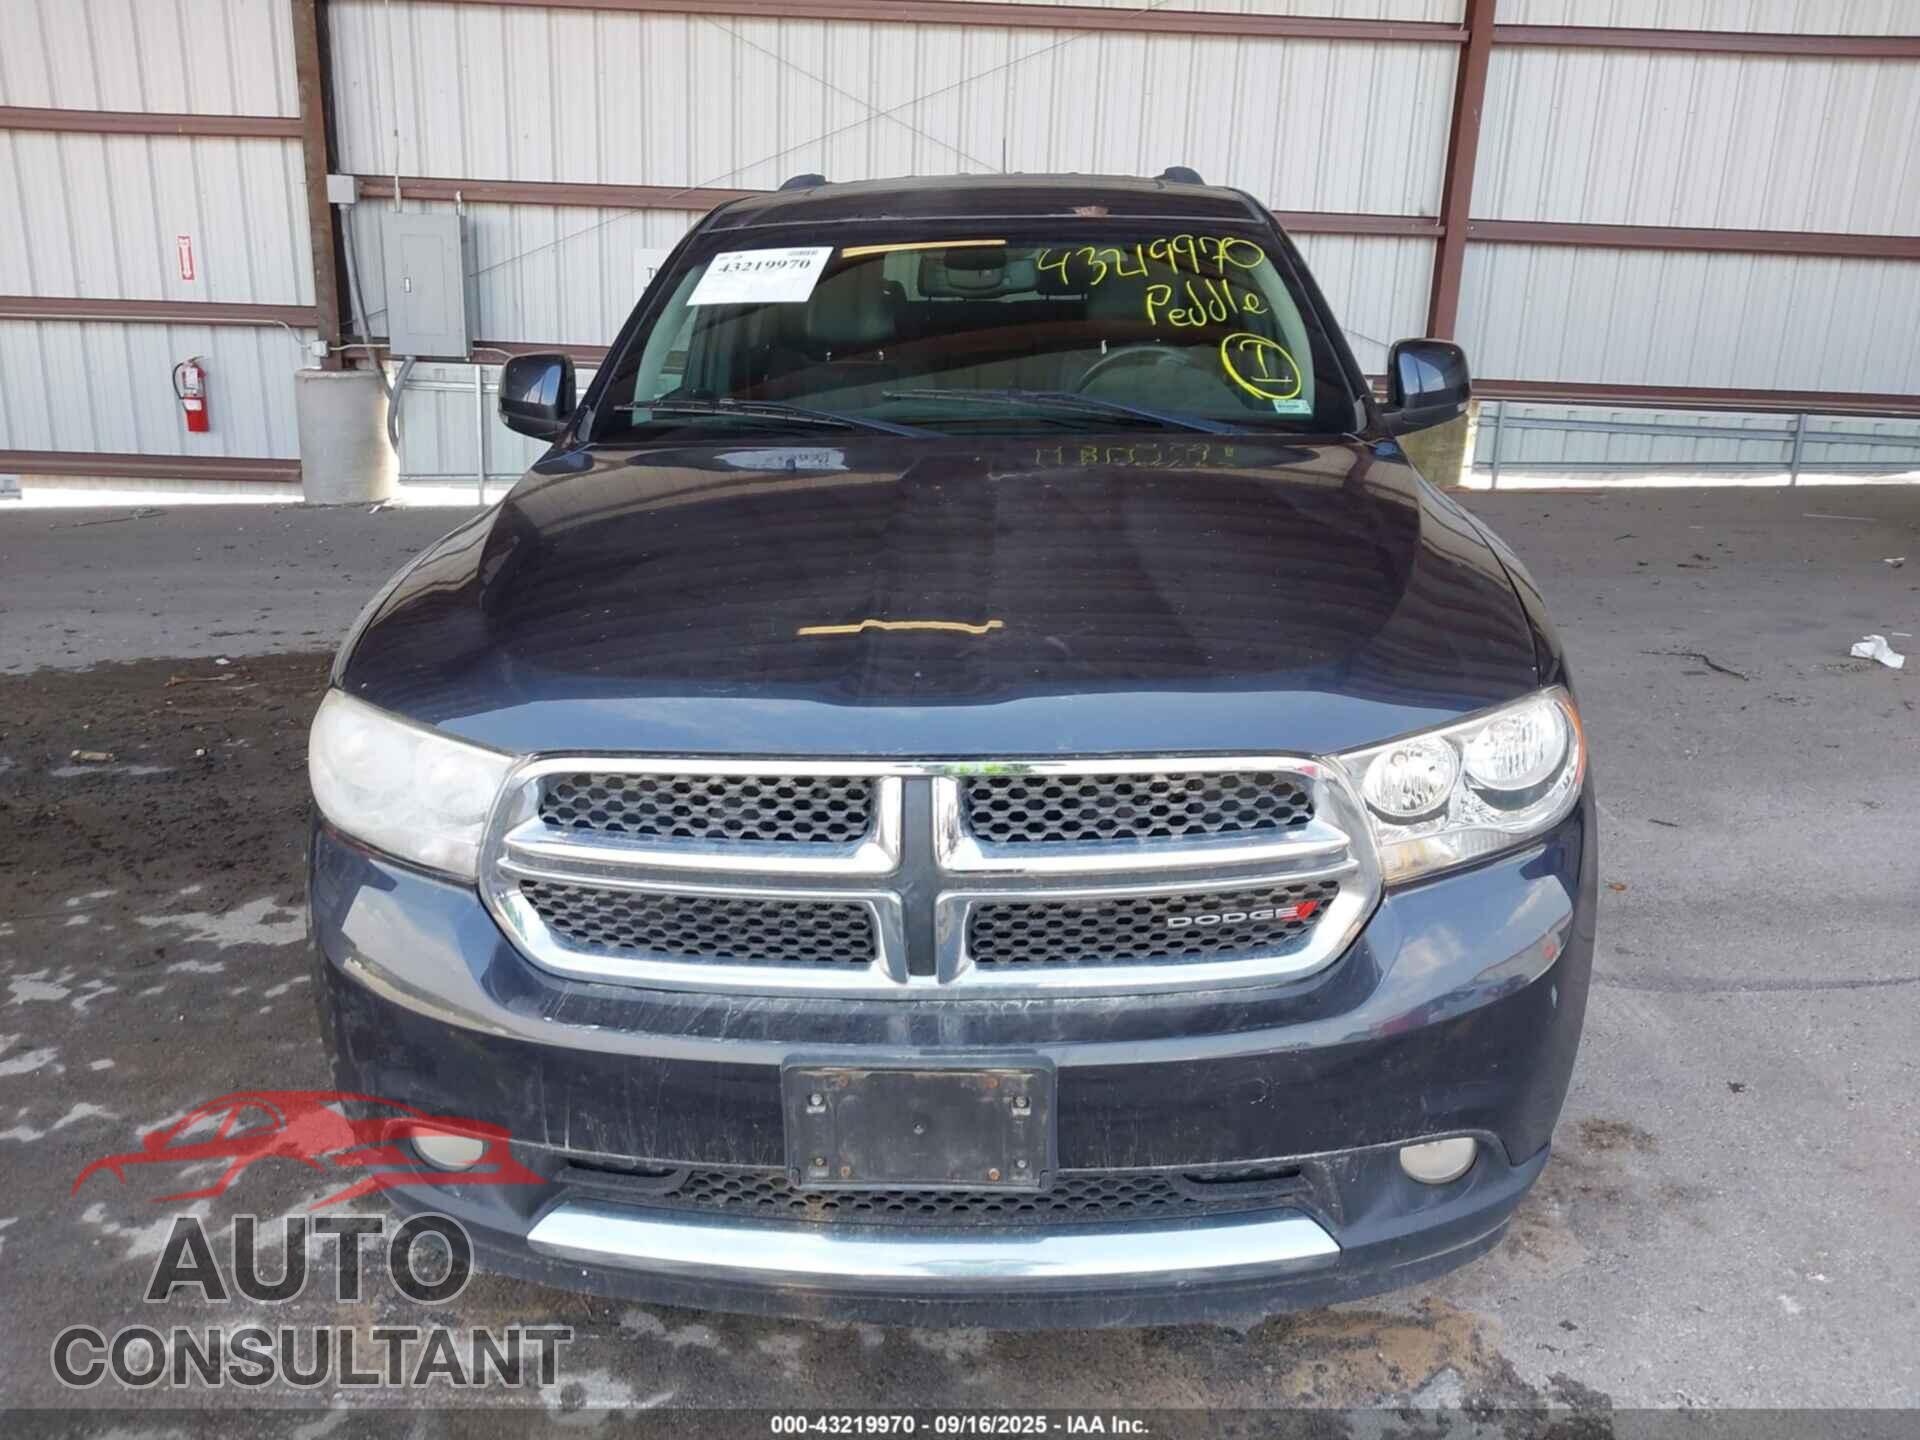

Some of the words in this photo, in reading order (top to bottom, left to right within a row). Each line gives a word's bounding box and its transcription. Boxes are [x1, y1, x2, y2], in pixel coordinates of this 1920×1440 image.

[717, 259, 811, 273] 43219970
[1037, 234, 1265, 286] 43219970
[1145, 278, 1269, 327] Peddle
[1167, 907, 1299, 929] DODGE
